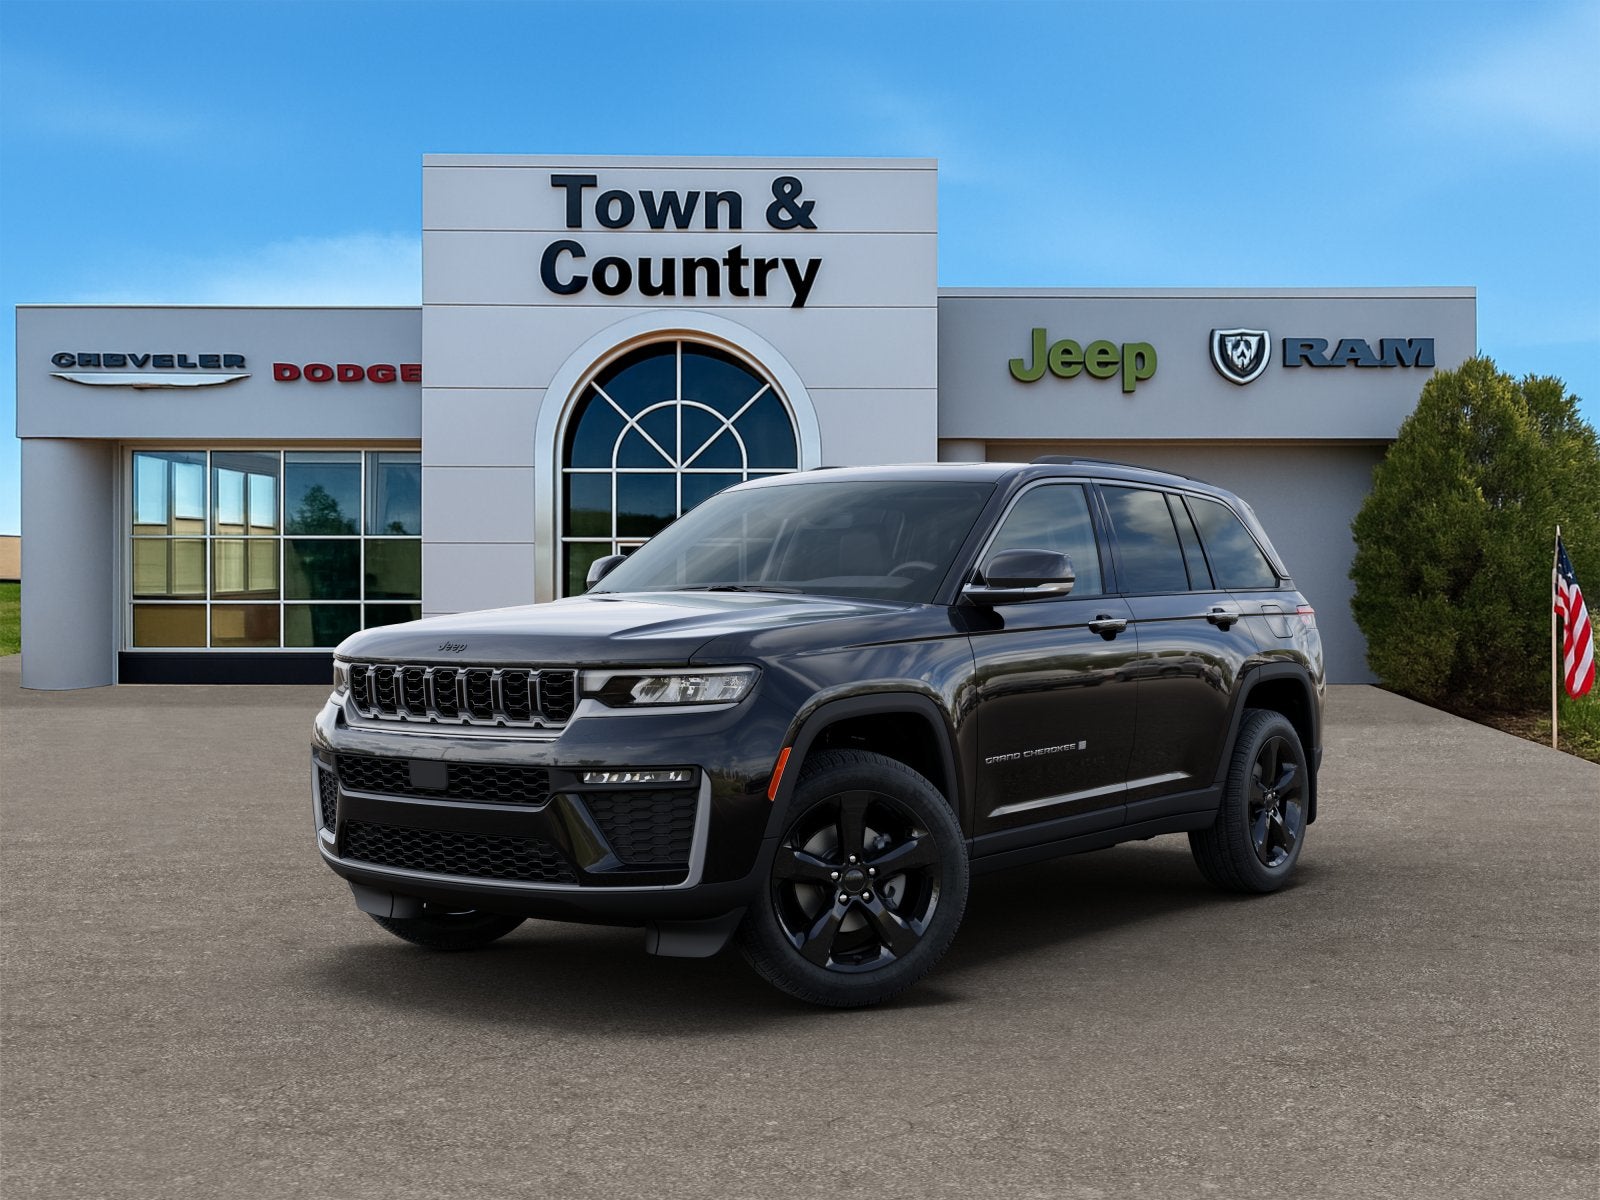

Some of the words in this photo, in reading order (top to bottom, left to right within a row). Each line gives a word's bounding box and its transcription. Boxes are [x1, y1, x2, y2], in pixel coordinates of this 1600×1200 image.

[550, 174, 743, 229] Town
[765, 175, 818, 230] &
[540, 239, 822, 308] Country
[1009, 328, 1158, 393] Jeep
[1283, 337, 1436, 368] RAM
[438, 641, 468, 653] Jeep
[985, 752, 1021, 764] GRAND
[1023, 743, 1077, 758] CHEROKEE
